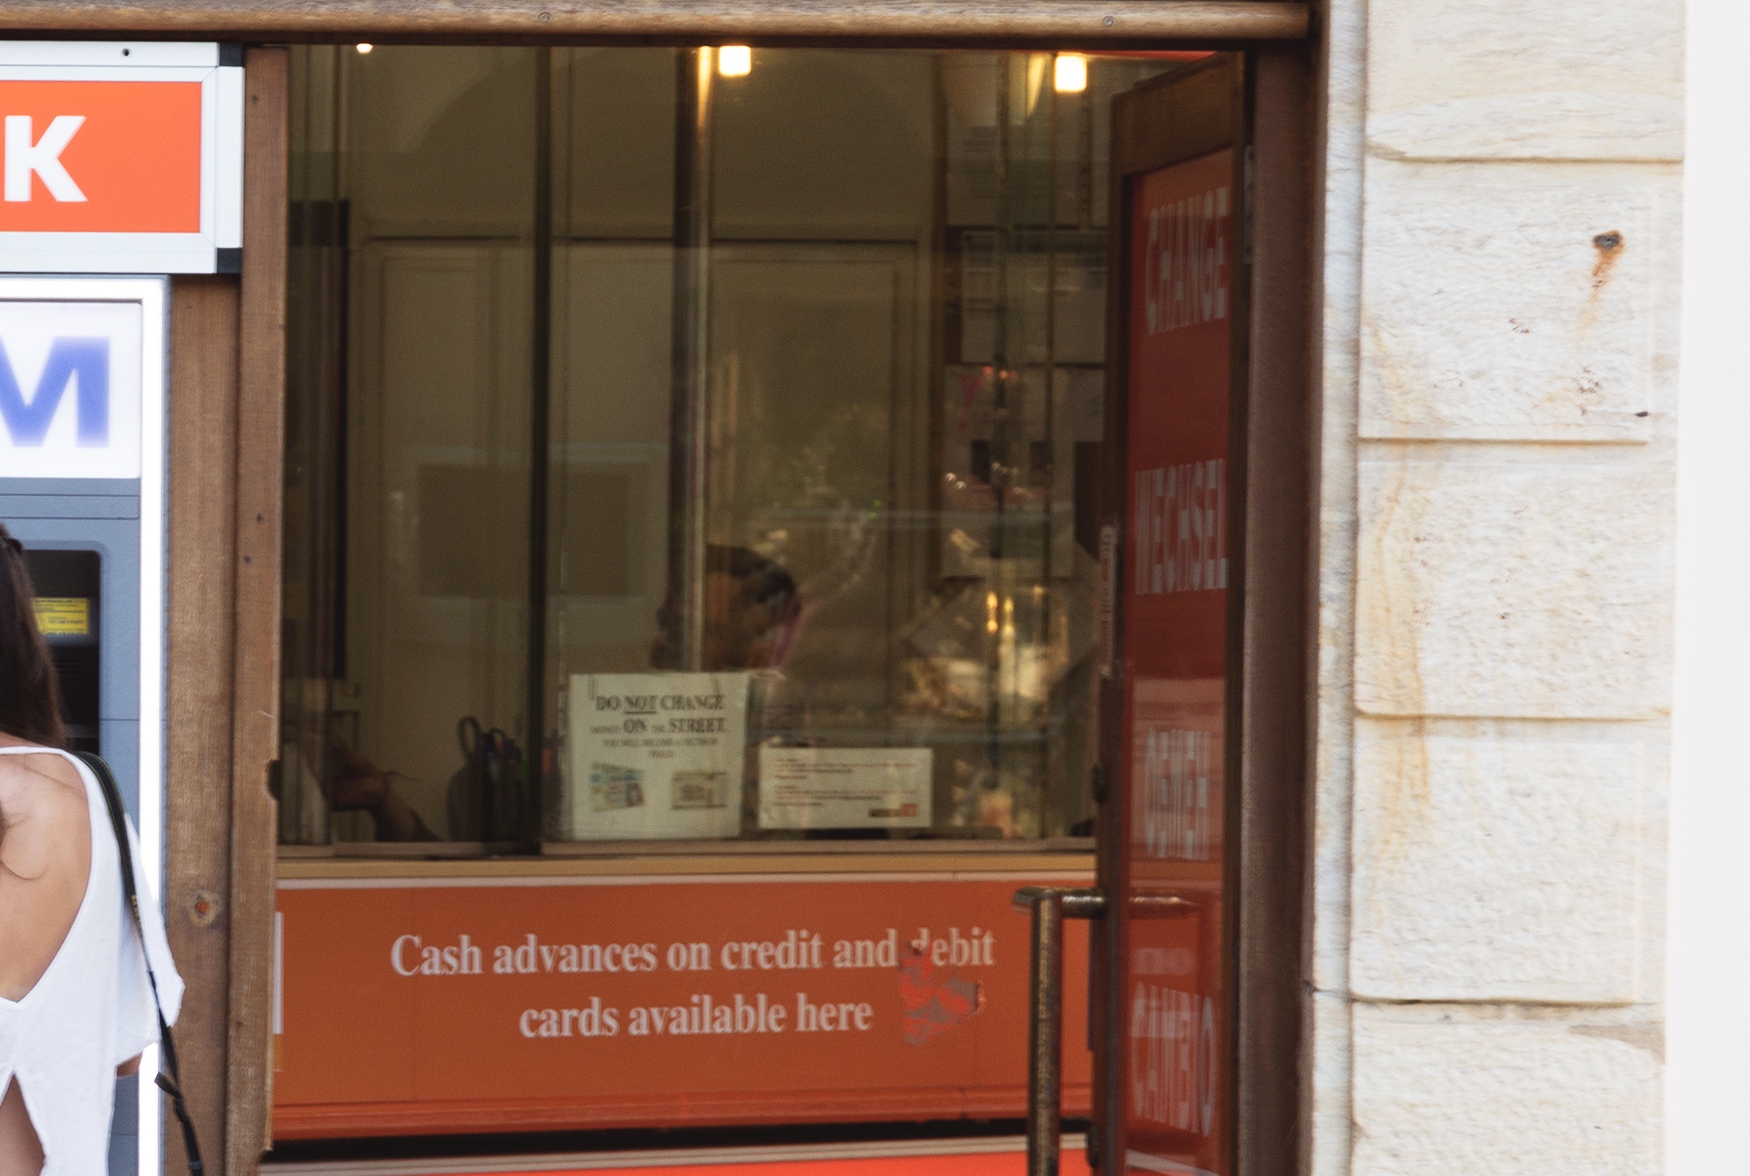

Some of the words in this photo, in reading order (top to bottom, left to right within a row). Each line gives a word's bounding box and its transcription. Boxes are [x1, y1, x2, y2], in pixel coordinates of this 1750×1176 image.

[1146, 186, 1229, 335] CHANGE
[1135, 458, 1229, 595] WECHSEL
[390, 934, 484, 976] Cash
[493, 933, 658, 974] advances
[666, 941, 712, 971] on
[720, 929, 825, 970] credit
[833, 927, 900, 969] and
[519, 996, 620, 1038] cards
[628, 993, 788, 1036] available
[794, 992, 875, 1032] here
